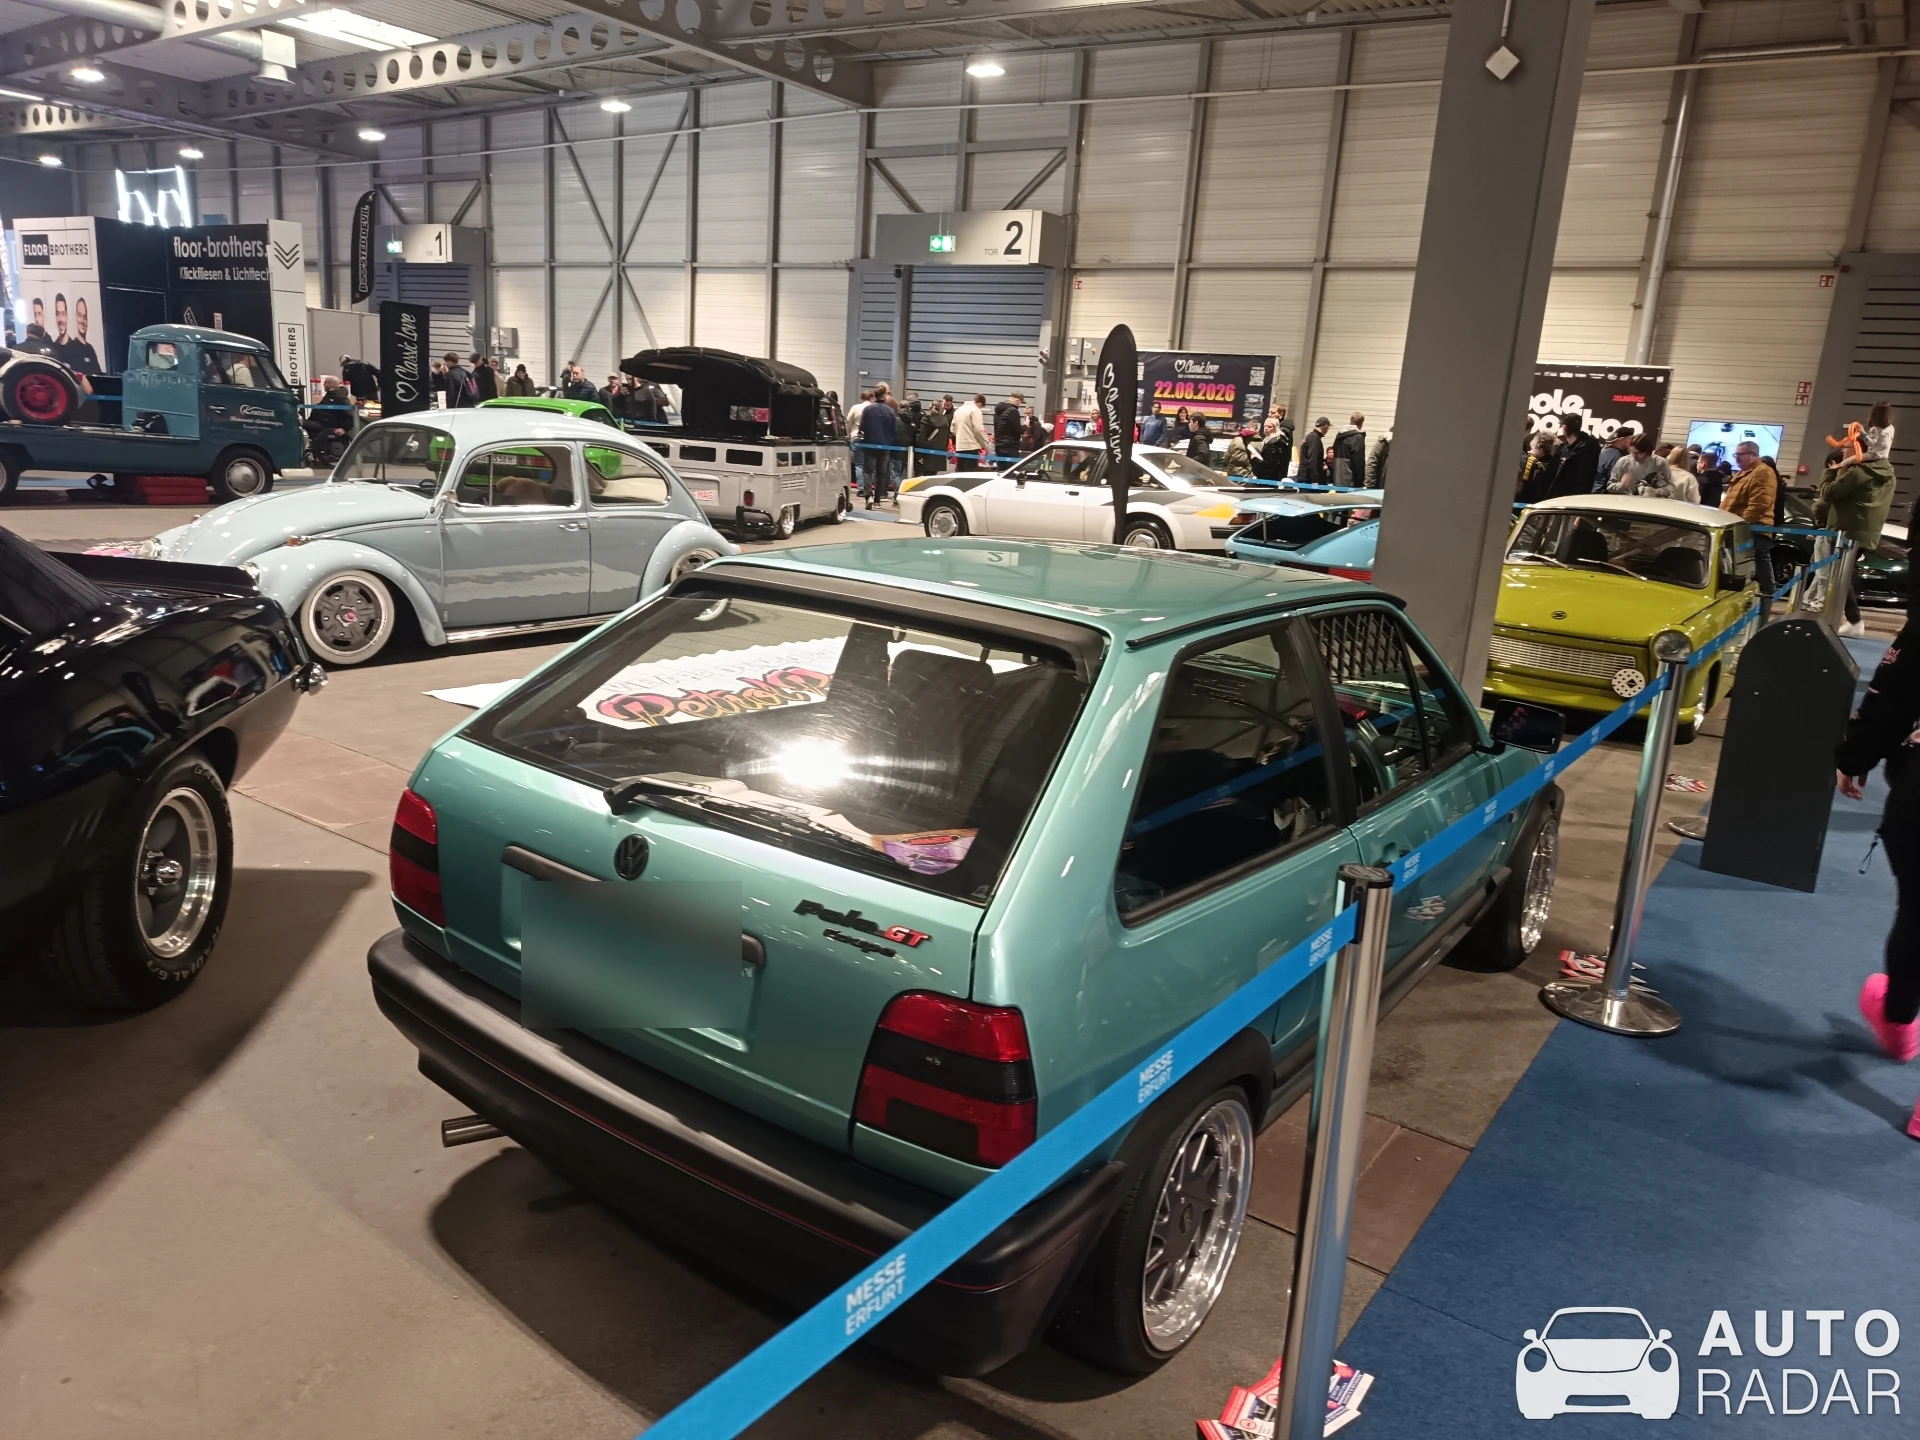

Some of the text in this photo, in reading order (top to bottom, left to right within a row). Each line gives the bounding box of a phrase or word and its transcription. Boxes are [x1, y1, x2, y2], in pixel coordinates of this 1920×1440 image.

[24, 243, 89, 256] FLOOR BROTHERS
[435, 231, 442, 256] 1
[985, 220, 1023, 256] TOR 2
[225, 267, 232, 280] &
[288, 327, 299, 384] BROTHERS
[395, 312, 419, 380] Classic Love
[1153, 380, 1236, 402] 22.08.2026
[698, 490, 714, 500] MAG
[597, 677, 811, 728] Petrol
[793, 899, 932, 948] Polo GT
[1138, 1066, 1173, 1103] ERFURT
[1139, 1049, 1173, 1086] MESSE
[846, 1253, 906, 1313] MESSE
[846, 1275, 906, 1335] ERFURT
